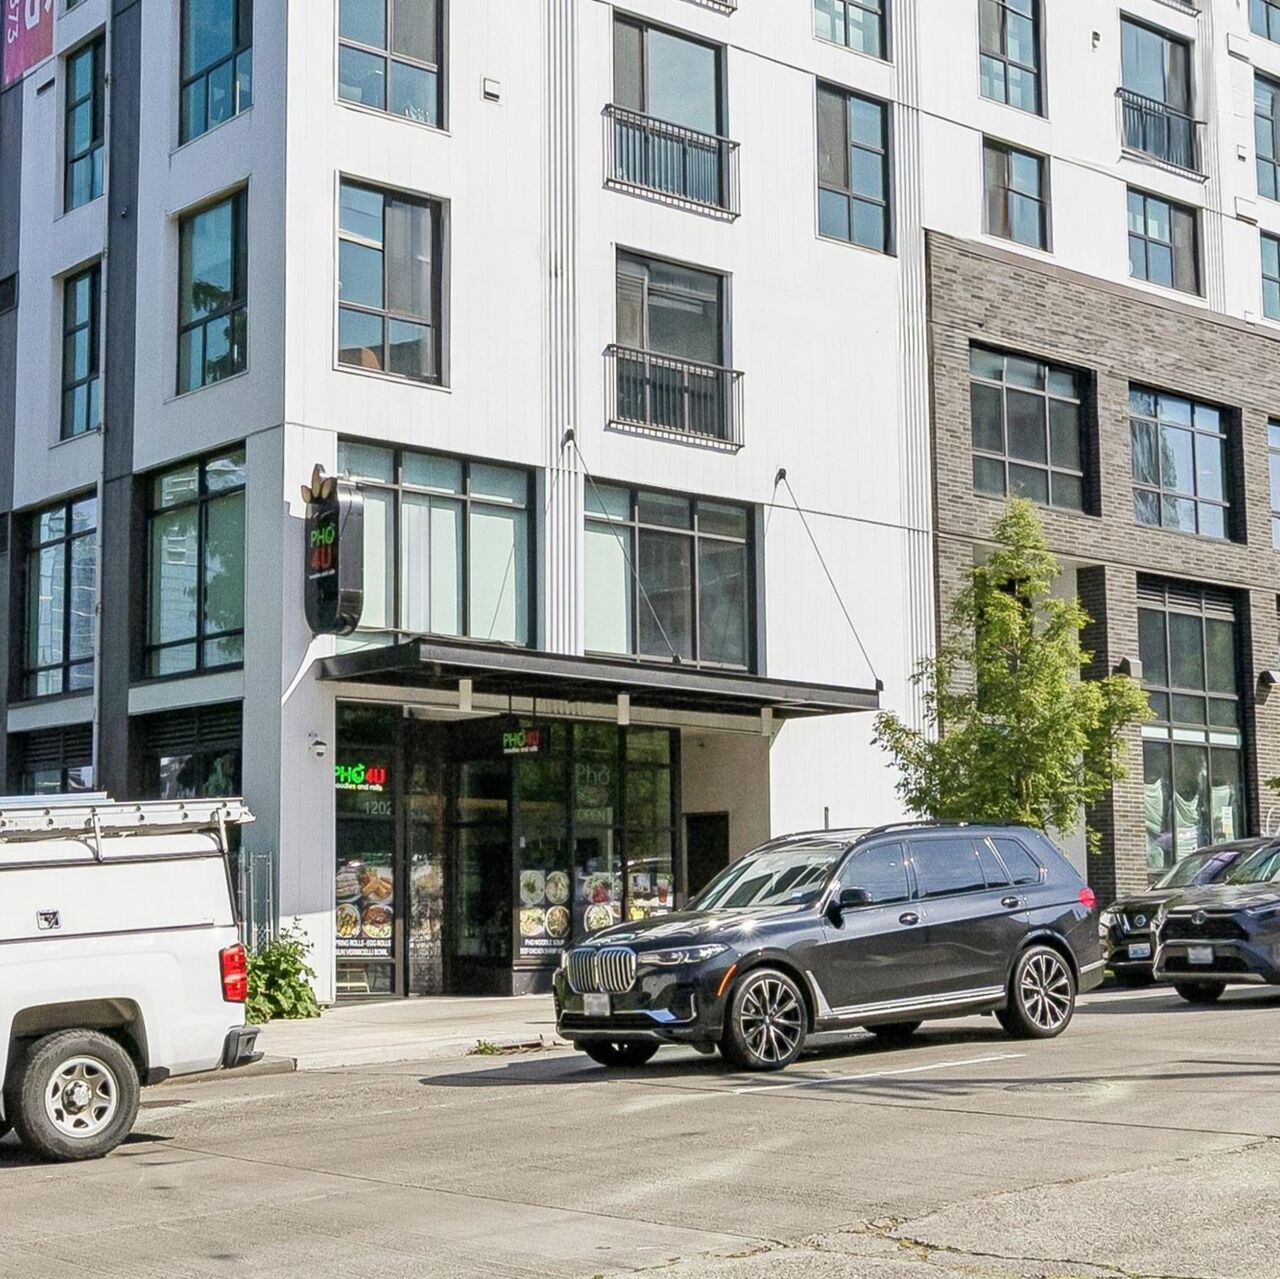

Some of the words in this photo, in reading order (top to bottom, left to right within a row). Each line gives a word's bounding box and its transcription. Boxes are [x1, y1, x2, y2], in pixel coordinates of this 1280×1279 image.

[312, 545, 332, 570] 4U
[365, 767, 386, 785] 4U
[364, 801, 392, 816] 1202
